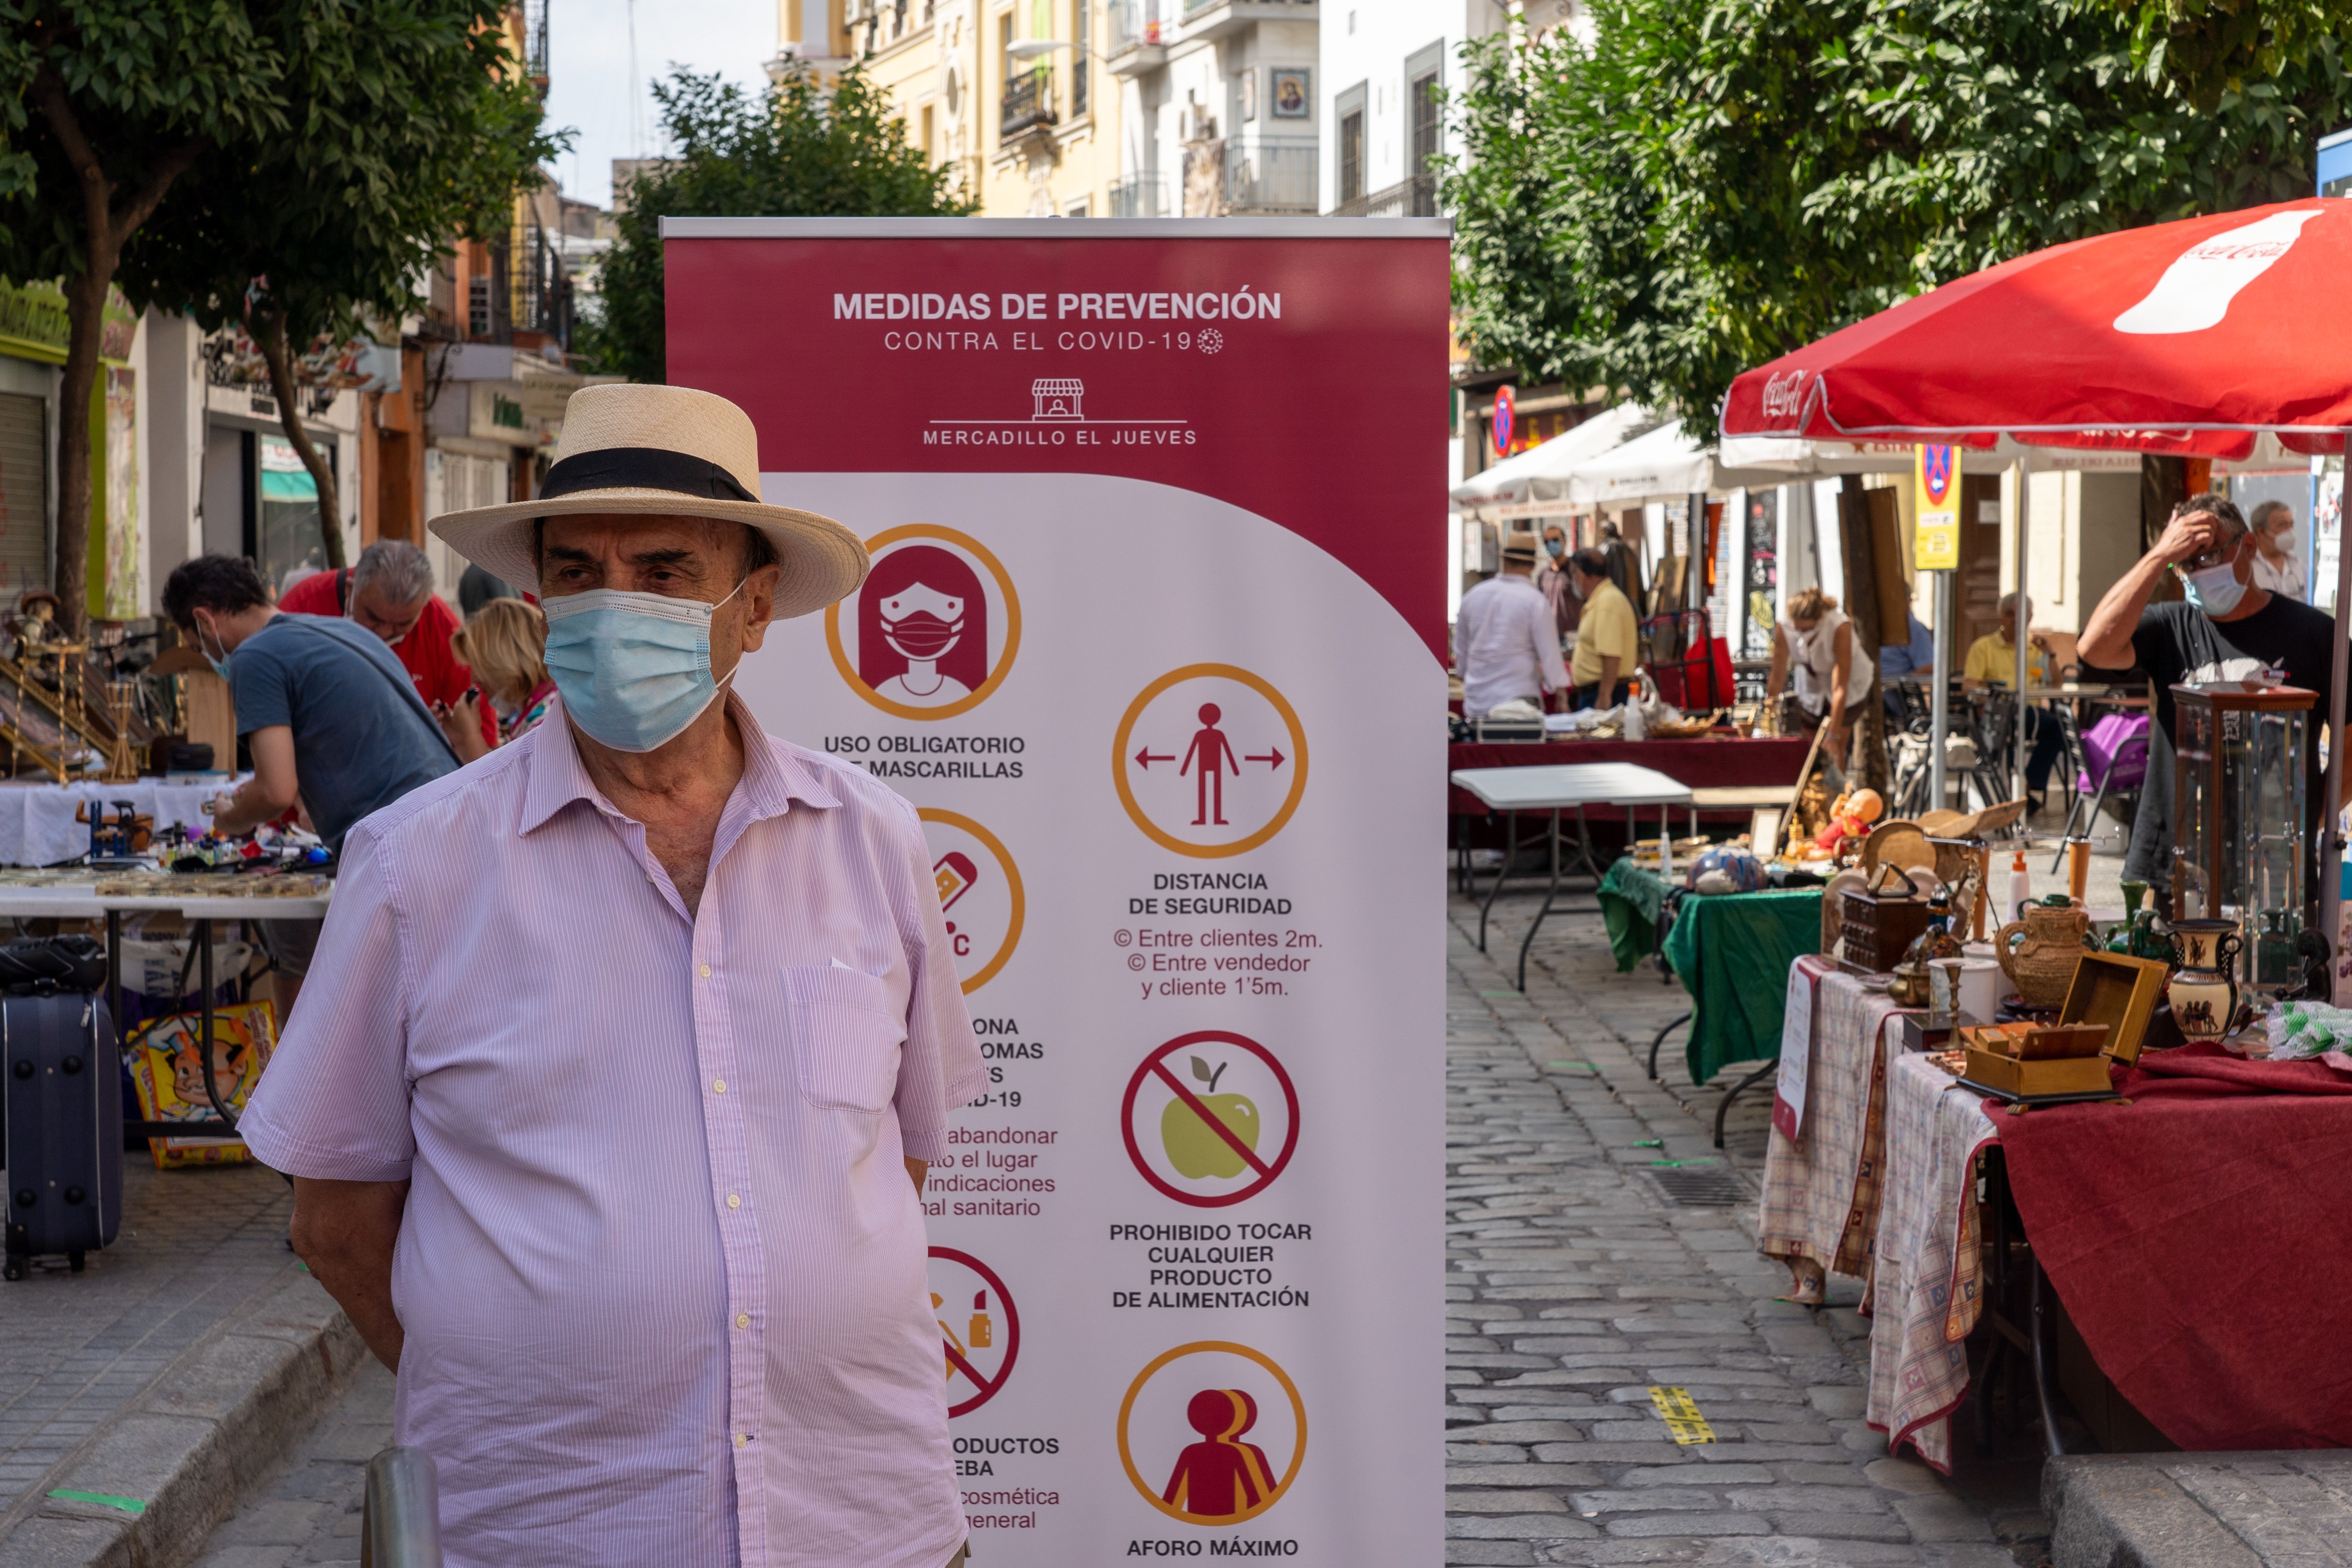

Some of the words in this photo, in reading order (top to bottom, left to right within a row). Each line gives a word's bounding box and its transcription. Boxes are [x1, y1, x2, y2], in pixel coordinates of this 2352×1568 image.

[834, 293, 992, 321] MEDIDAS
[1002, 293, 1048, 320] DE
[1058, 285, 1281, 320] PREVENCIÓN
[885, 332, 999, 351] CONTRA
[1014, 332, 1045, 351] EL
[1058, 332, 1191, 351] COVID-19
[924, 431, 1066, 446] MERCADILLO
[1077, 431, 1102, 445] EL
[1112, 430, 1197, 445] JUEVES
[825, 736, 871, 754] USO
[878, 736, 1025, 754] OBLIGATORIO
[870, 761, 1024, 779] MASCARILLAS
[1154, 873, 1269, 891] DISTANCIA
[1129, 898, 1159, 915] DE
[1165, 898, 1293, 915] SEGURIDAD
[1139, 929, 1194, 948] Entre
[1201, 929, 1279, 948] clientes
[1285, 930, 1323, 948] 2m.
[1153, 953, 1207, 972] Entre
[1214, 953, 1311, 973] vendedor
[1141, 982, 1154, 1000] y
[1160, 978, 1227, 997] cliente
[980, 1043, 1044, 1059] OMAS
[948, 1126, 1059, 1145] abandonar
[962, 1150, 979, 1169] el
[987, 1150, 1039, 1173] lugar
[928, 1174, 1056, 1192] indicaciones
[953, 1198, 1041, 1216] sanitario
[1110, 1224, 1231, 1241] PROHIBIDO
[1237, 1223, 1312, 1241] TOCAR
[1148, 1246, 1274, 1265] CUALQUIER
[1151, 1268, 1273, 1286] PRODUCTO
[1113, 1292, 1142, 1308] DE
[1147, 1285, 1310, 1309] ALIMENTACIÓN
[953, 1437, 1060, 1455] ODUCTOS
[954, 1460, 995, 1477] EBA
[1127, 1540, 1203, 1557] AFORO
[1210, 1536, 1299, 1557] MÁXIMO
